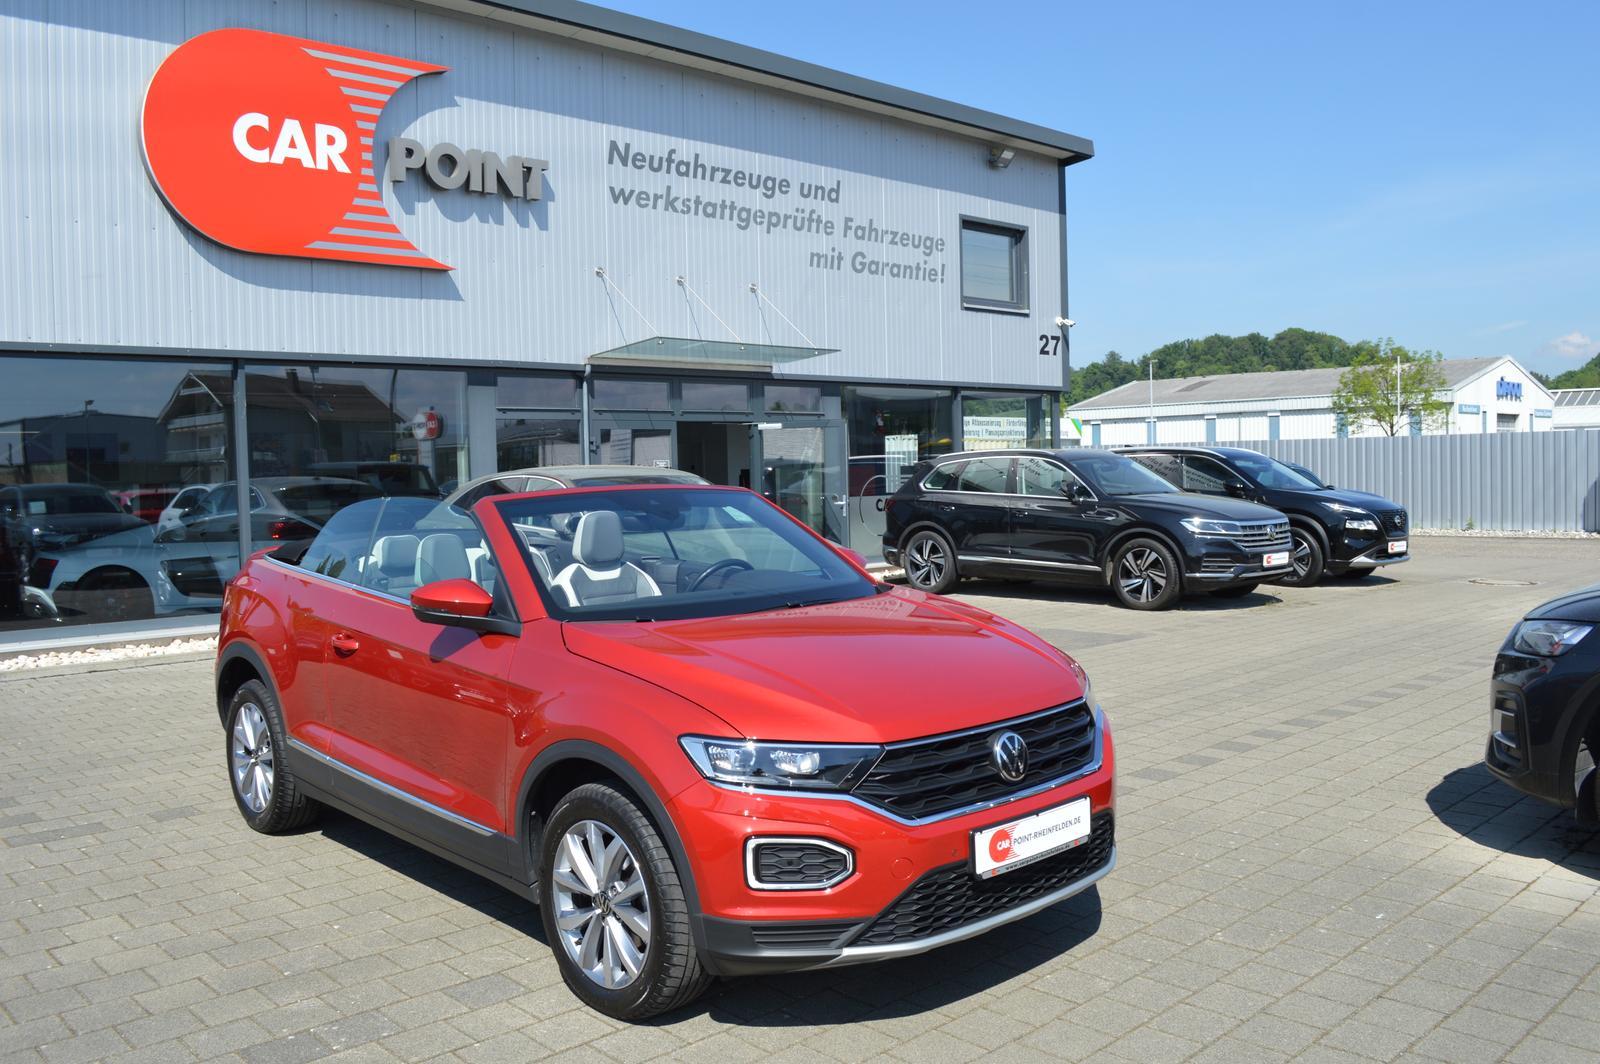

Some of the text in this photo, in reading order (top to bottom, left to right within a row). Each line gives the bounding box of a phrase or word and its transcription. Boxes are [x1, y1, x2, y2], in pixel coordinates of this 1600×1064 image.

[233, 112, 549, 201] CAR POINT
[607, 139, 841, 204] Neufahrzeuge und
[608, 185, 946, 255] werkstattgeprüfte Fahrzeuge
[808, 247, 946, 284] mit Garantie!
[1039, 334, 1061, 356] 27
[996, 816, 1081, 851] CAR POINT-RHEINFELDEN.DE
